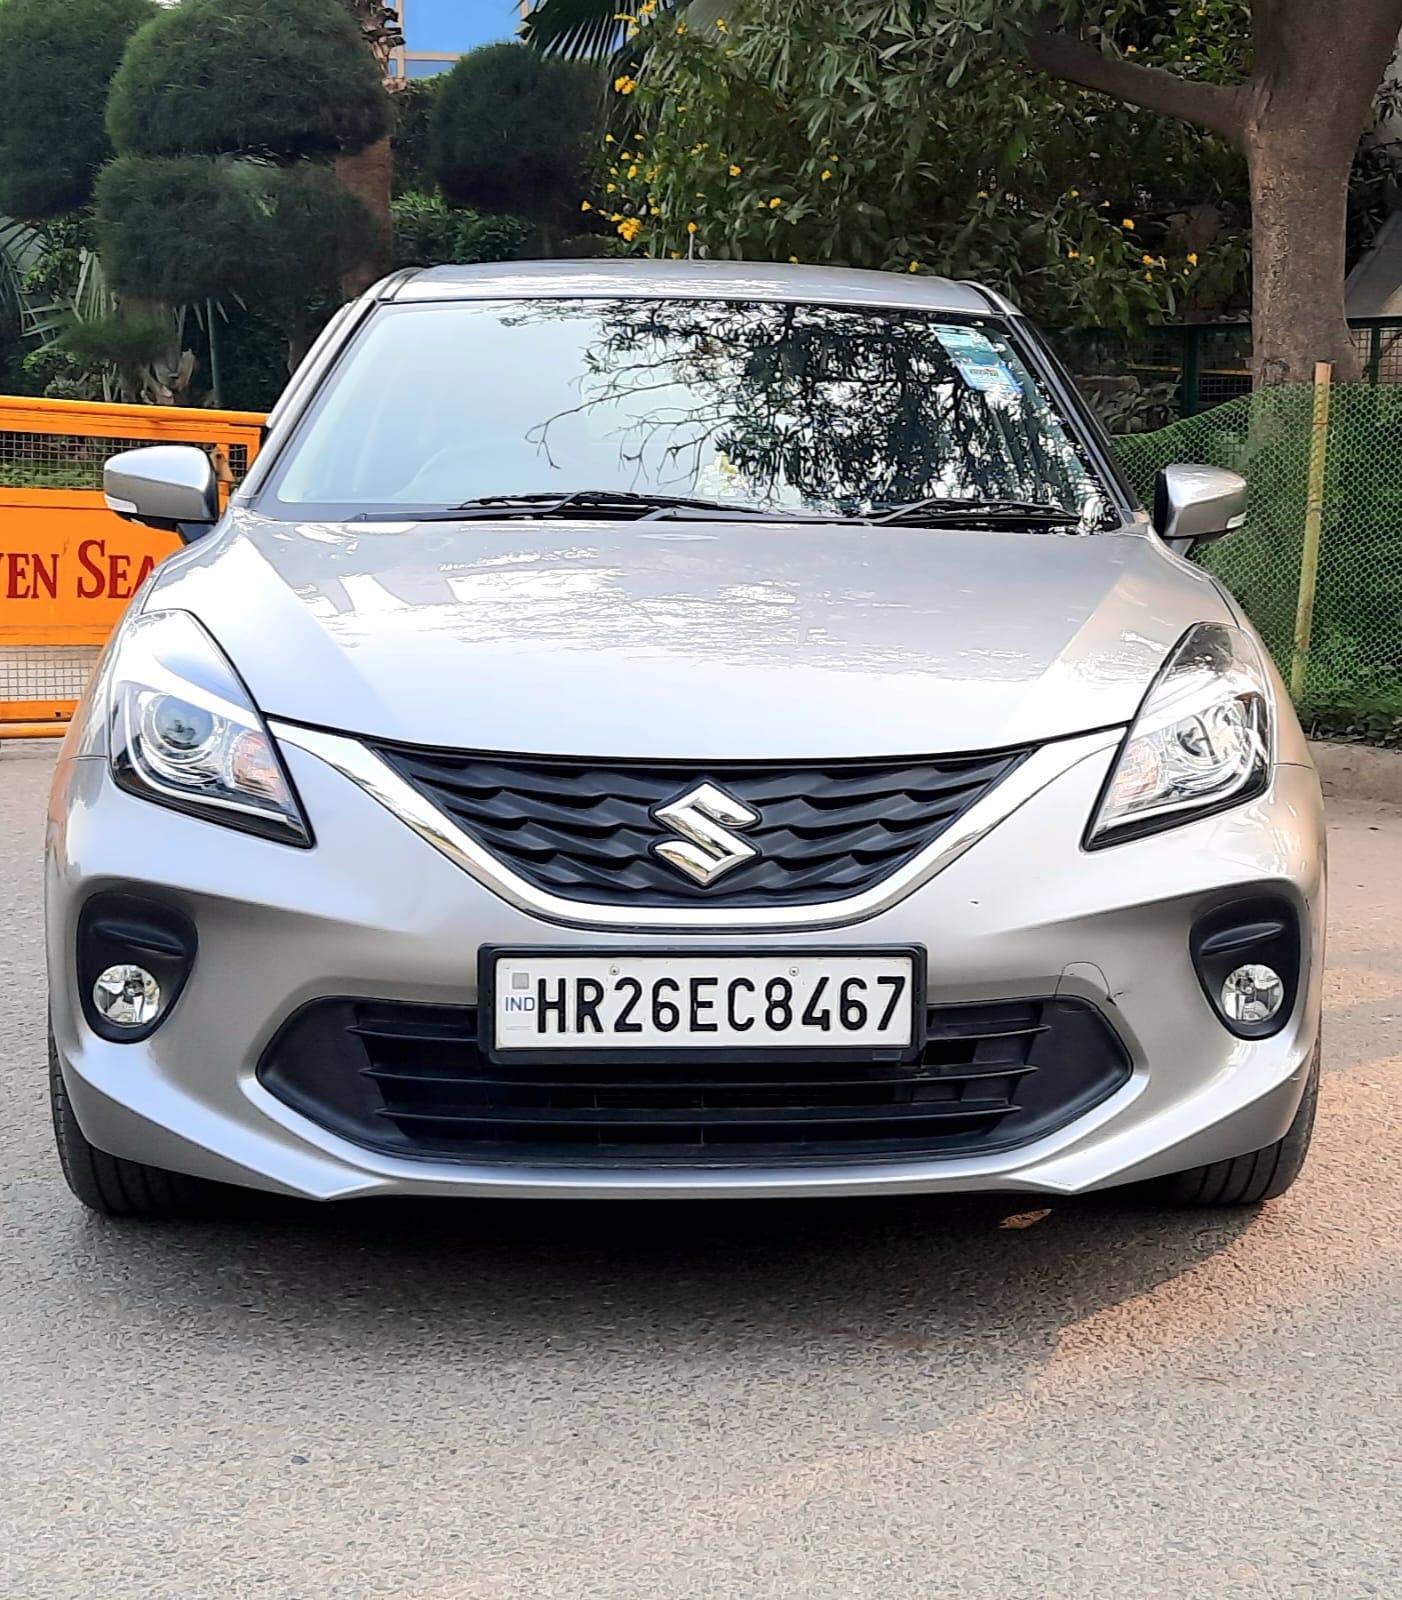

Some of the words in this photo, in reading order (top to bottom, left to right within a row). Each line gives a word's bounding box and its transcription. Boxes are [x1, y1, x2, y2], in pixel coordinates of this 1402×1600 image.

[0, 553, 60, 599] EN
[505, 996, 536, 1012] IND
[537, 976, 906, 1034] HR26EC8467
